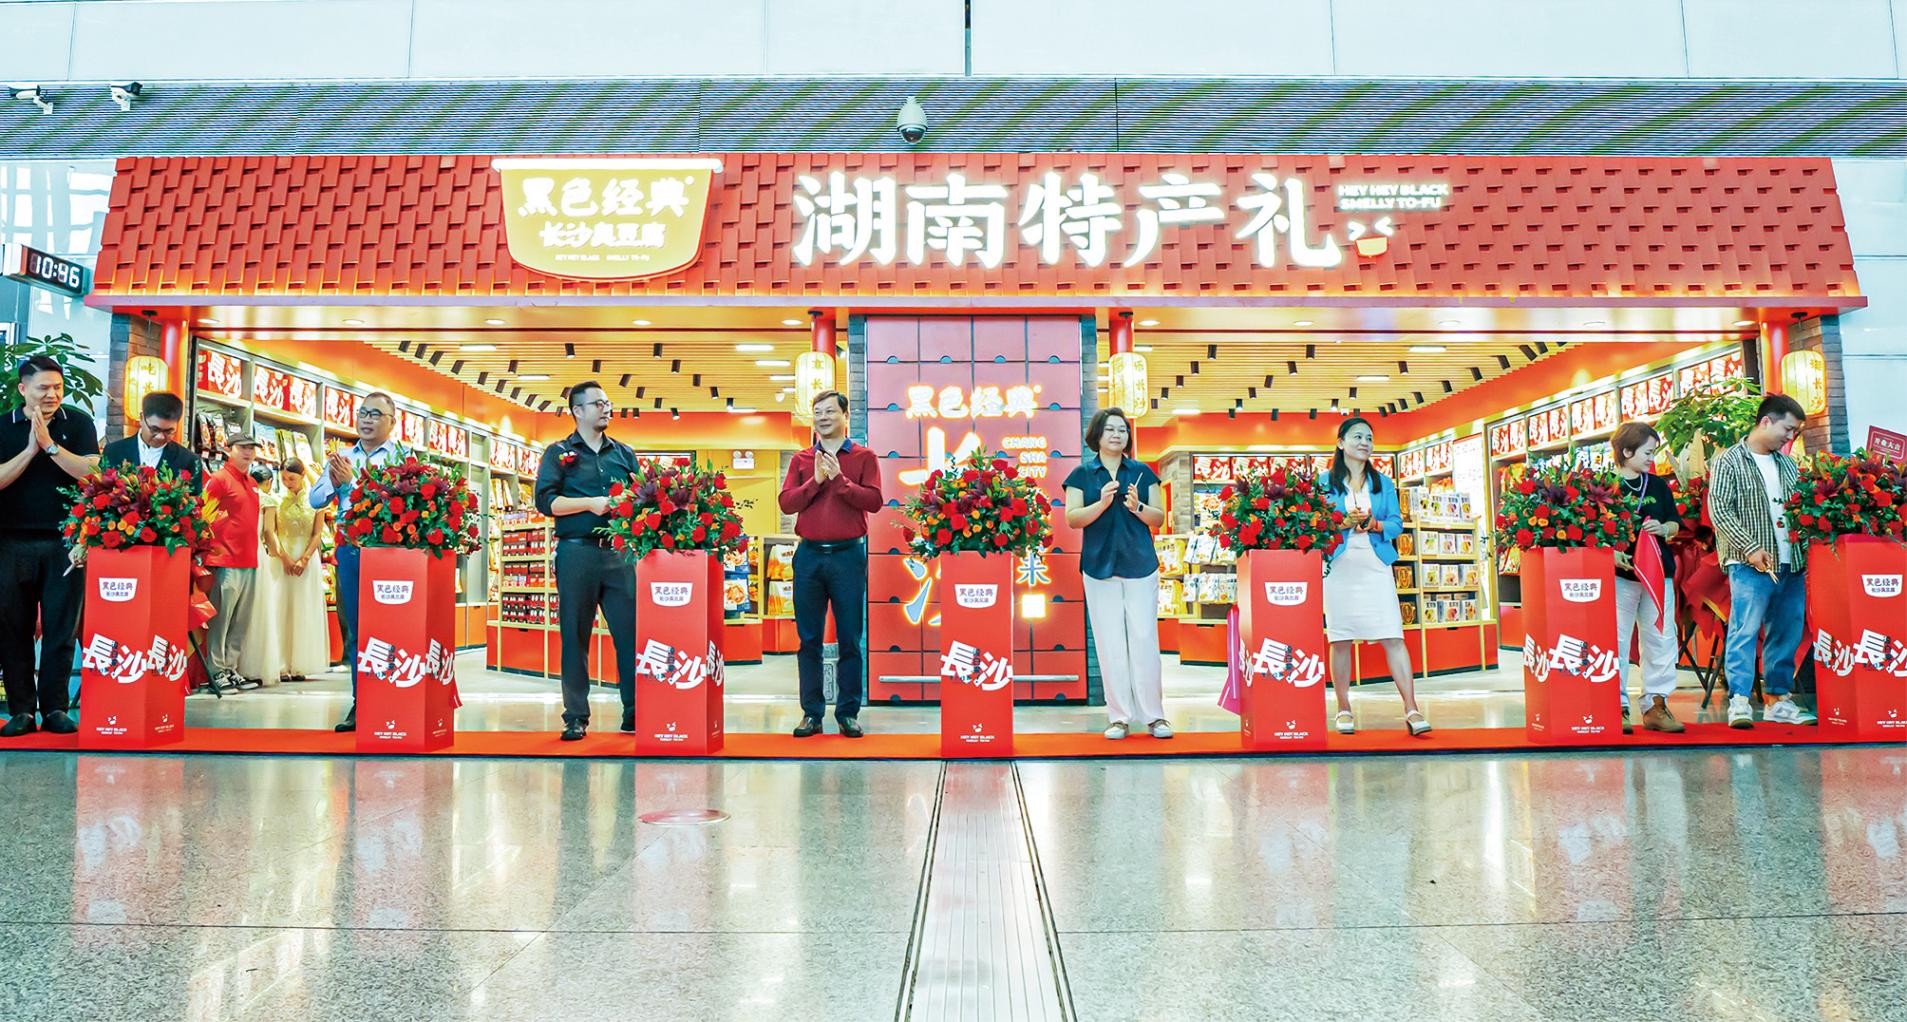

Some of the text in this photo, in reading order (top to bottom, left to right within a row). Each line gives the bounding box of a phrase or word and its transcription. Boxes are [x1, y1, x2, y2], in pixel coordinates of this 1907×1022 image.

[518, 176, 689, 217] 黑色经典
[1338, 183, 1449, 196] HEY HEY BLACK
[1340, 197, 1441, 210] SMELLY TO-FU
[792, 171, 1342, 269] 湖南特产礼
[539, 222, 666, 249] 长沙臭豆腐
[906, 386, 1039, 418] 黑色经典
[1002, 436, 1047, 449] CHANG
[1020, 451, 1047, 463] SHA
[1018, 466, 1047, 478] CITY
[377, 584, 410, 594] 黑色经典
[655, 586, 689, 595] 黑色经典
[959, 588, 993, 597] 黑色经典
[1269, 586, 1304, 595] 黑色经典
[1564, 582, 1598, 592] 黑色经典
[1866, 578, 1899, 587] 黑色经典
[82, 633, 147, 684] 長沙
[146, 634, 187, 682] 長沙
[358, 636, 425, 688] 長沙
[636, 638, 706, 690] 長沙
[941, 640, 1013, 691] 長沙
[1252, 637, 1325, 688] 長沙
[1548, 634, 1619, 683] 長沙
[1813, 628, 1856, 677] 長沙
